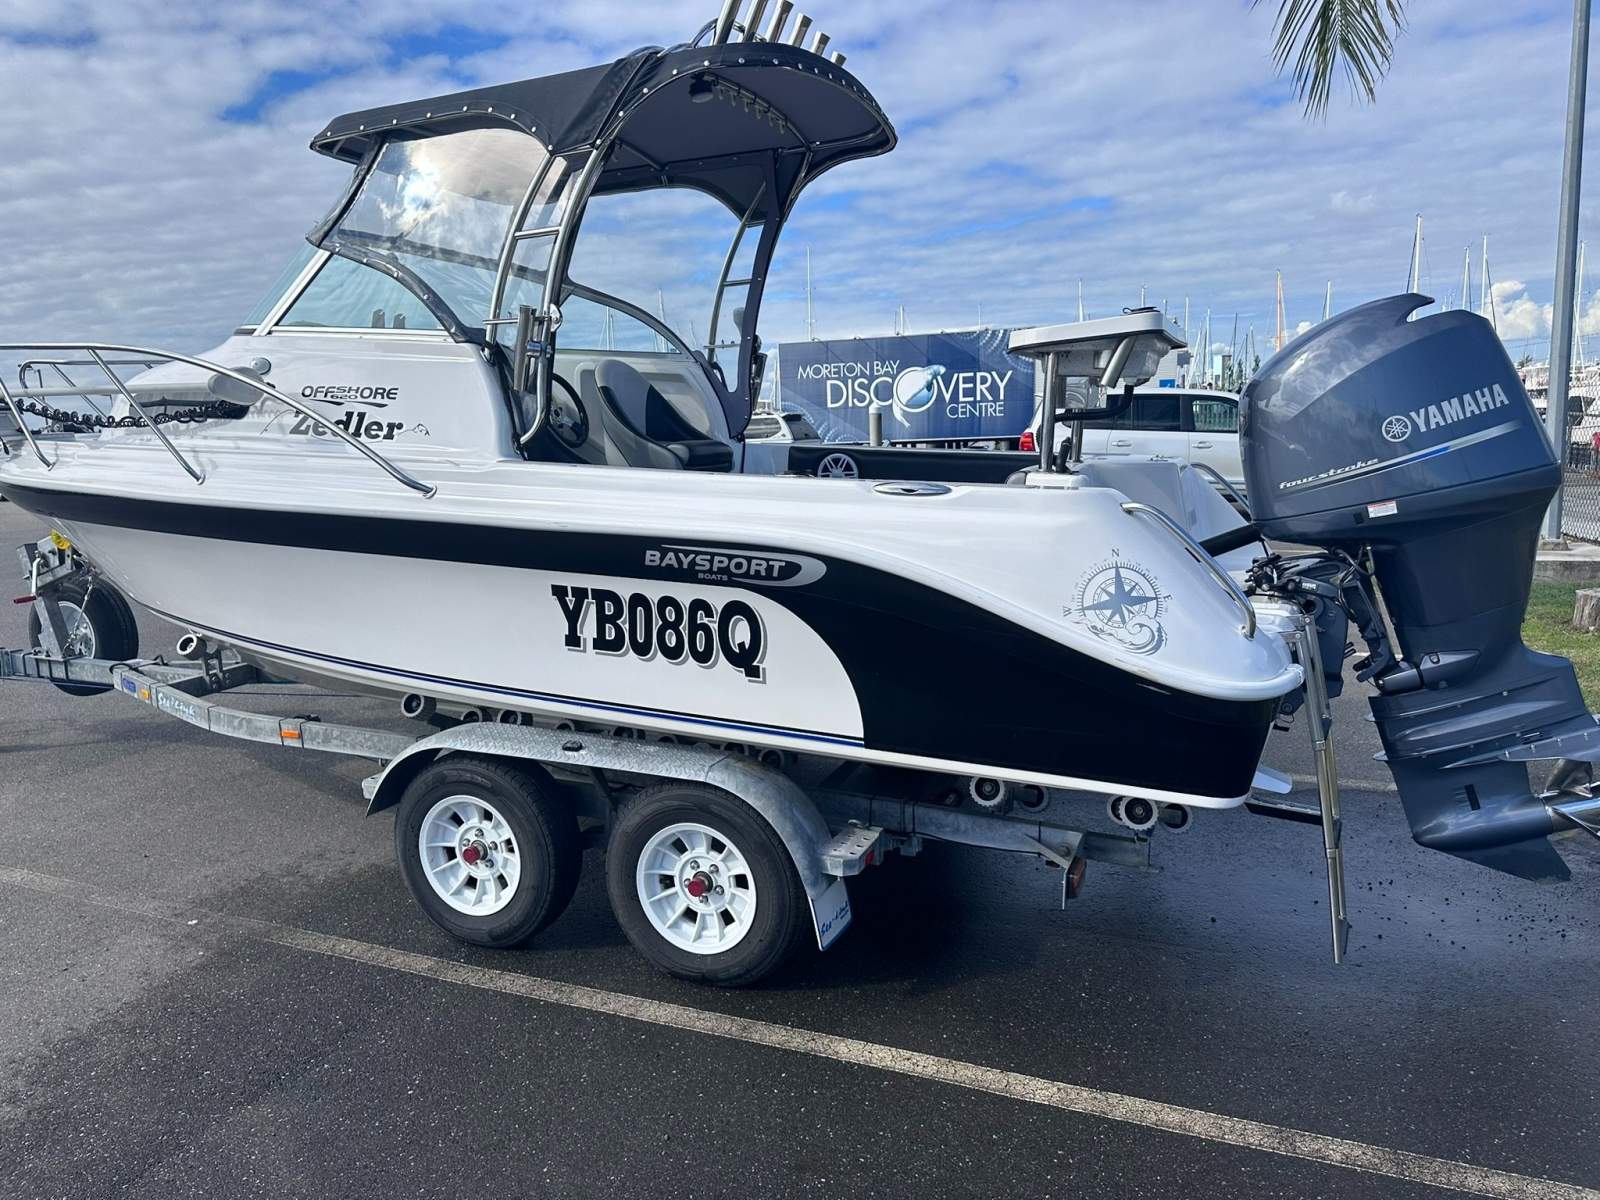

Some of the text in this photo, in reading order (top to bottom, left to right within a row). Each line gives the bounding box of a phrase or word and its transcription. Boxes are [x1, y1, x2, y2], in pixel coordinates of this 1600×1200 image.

[798, 360, 900, 379] MORETON BAY
[301, 386, 399, 400] OFFSHORE
[827, 367, 1013, 412] DISCOVERY
[946, 402, 1004, 418] CENTRE
[1409, 384, 1510, 433] YAMAHA
[1112, 548, 1120, 557] N
[645, 550, 785, 577] BAYSPORT
[698, 573, 728, 581] BOATS
[1062, 606, 1072, 617] W
[551, 584, 767, 684] YB086Q
